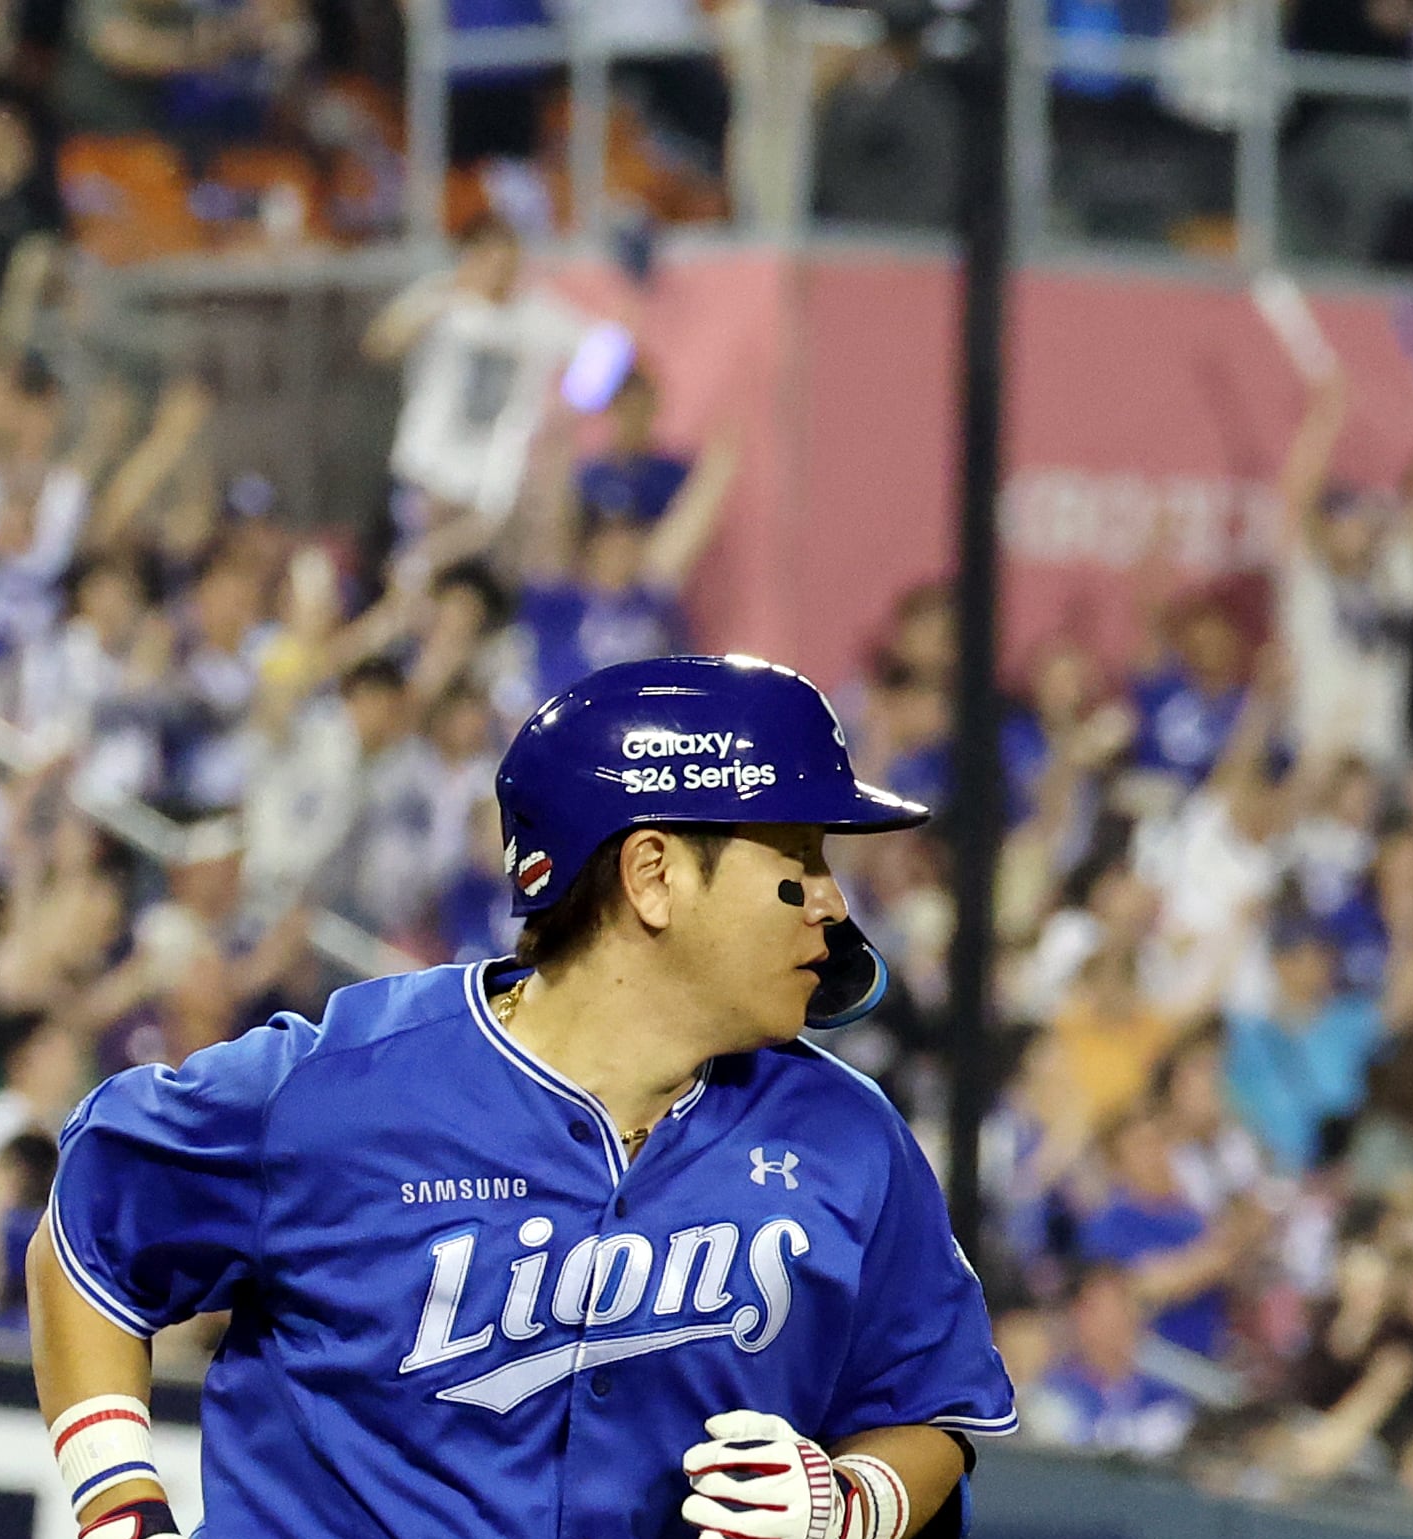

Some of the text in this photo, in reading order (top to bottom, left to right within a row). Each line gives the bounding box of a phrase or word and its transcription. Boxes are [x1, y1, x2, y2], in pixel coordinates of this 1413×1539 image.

[621, 731, 733, 760] Galaxy
[622, 761, 776, 794] S26 Series
[400, 1177, 528, 1204] SAMSUNG
[398, 1216, 810, 1413] Lions
